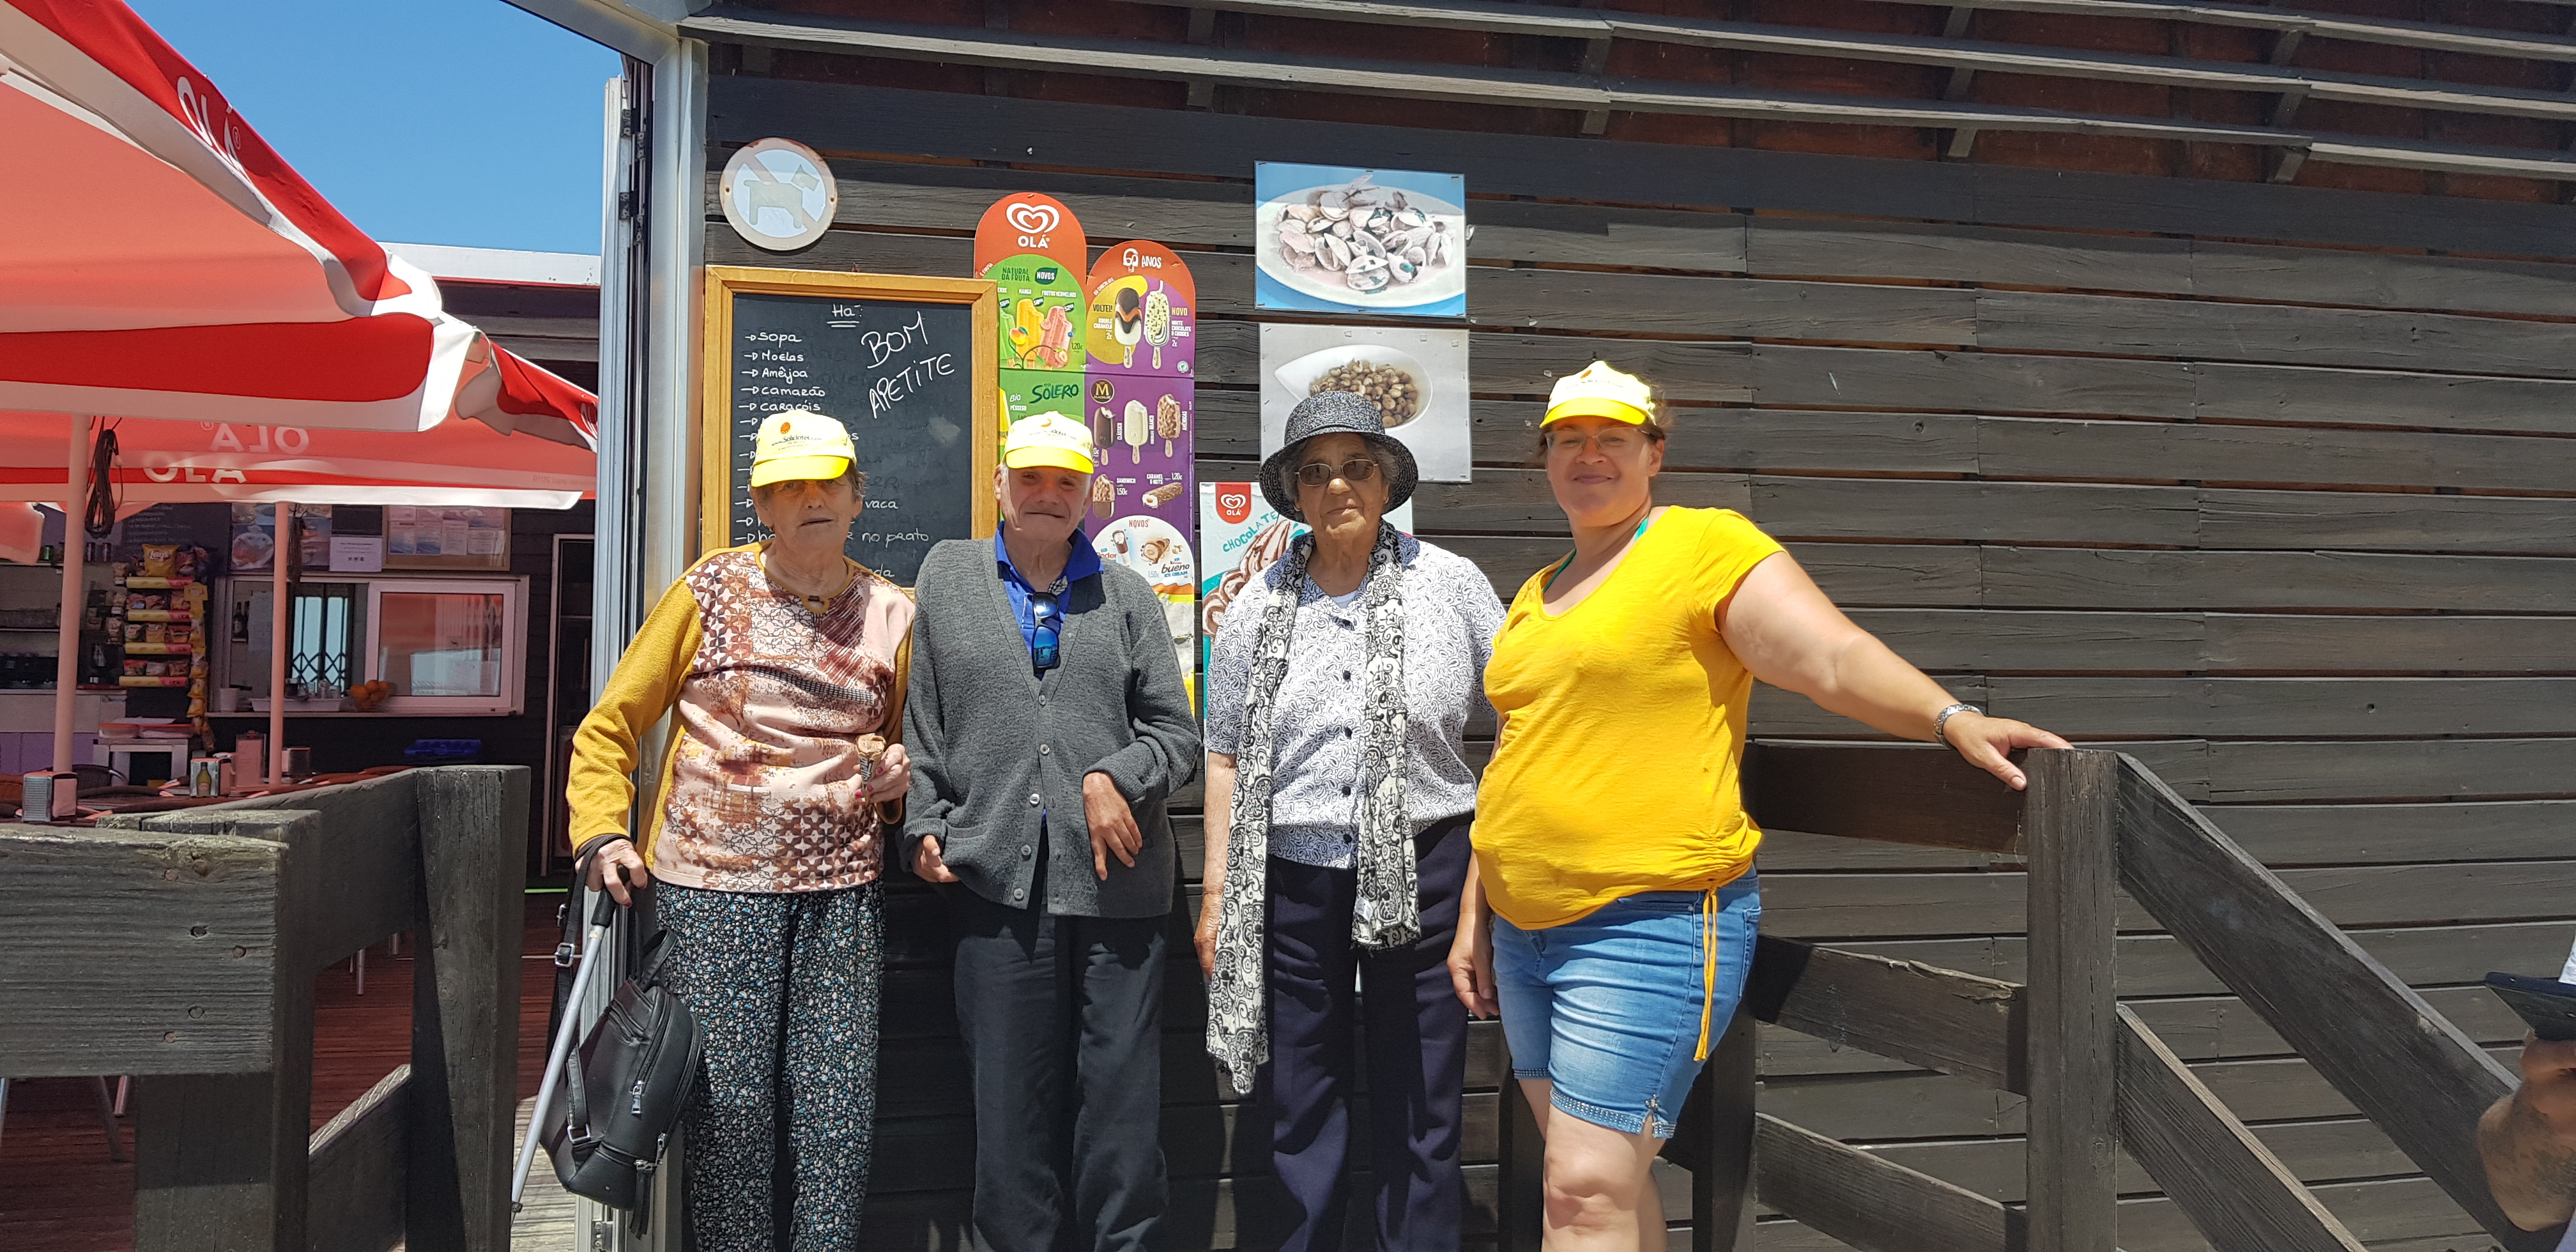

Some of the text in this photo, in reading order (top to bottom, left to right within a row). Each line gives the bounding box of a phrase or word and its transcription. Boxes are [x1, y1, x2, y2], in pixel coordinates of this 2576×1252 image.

[1018, 234, 1048, 248] OLÁ
[1142, 256, 1162, 269] ANOS
[1002, 267, 1029, 275] NATURAL
[1036, 271, 1055, 280] NOVOS
[1171, 307, 1188, 316] NOVO
[861, 310, 928, 369] BOM
[869, 353, 954, 419] APETITE
[1029, 383, 1079, 404] SOLERO
[864, 500, 898, 509] vaca
[1129, 519, 1149, 528] NOVOS
[1222, 510, 1278, 553] CHOCOLATE
[862, 532, 880, 543] no
[1161, 563, 1190, 574] bueno
